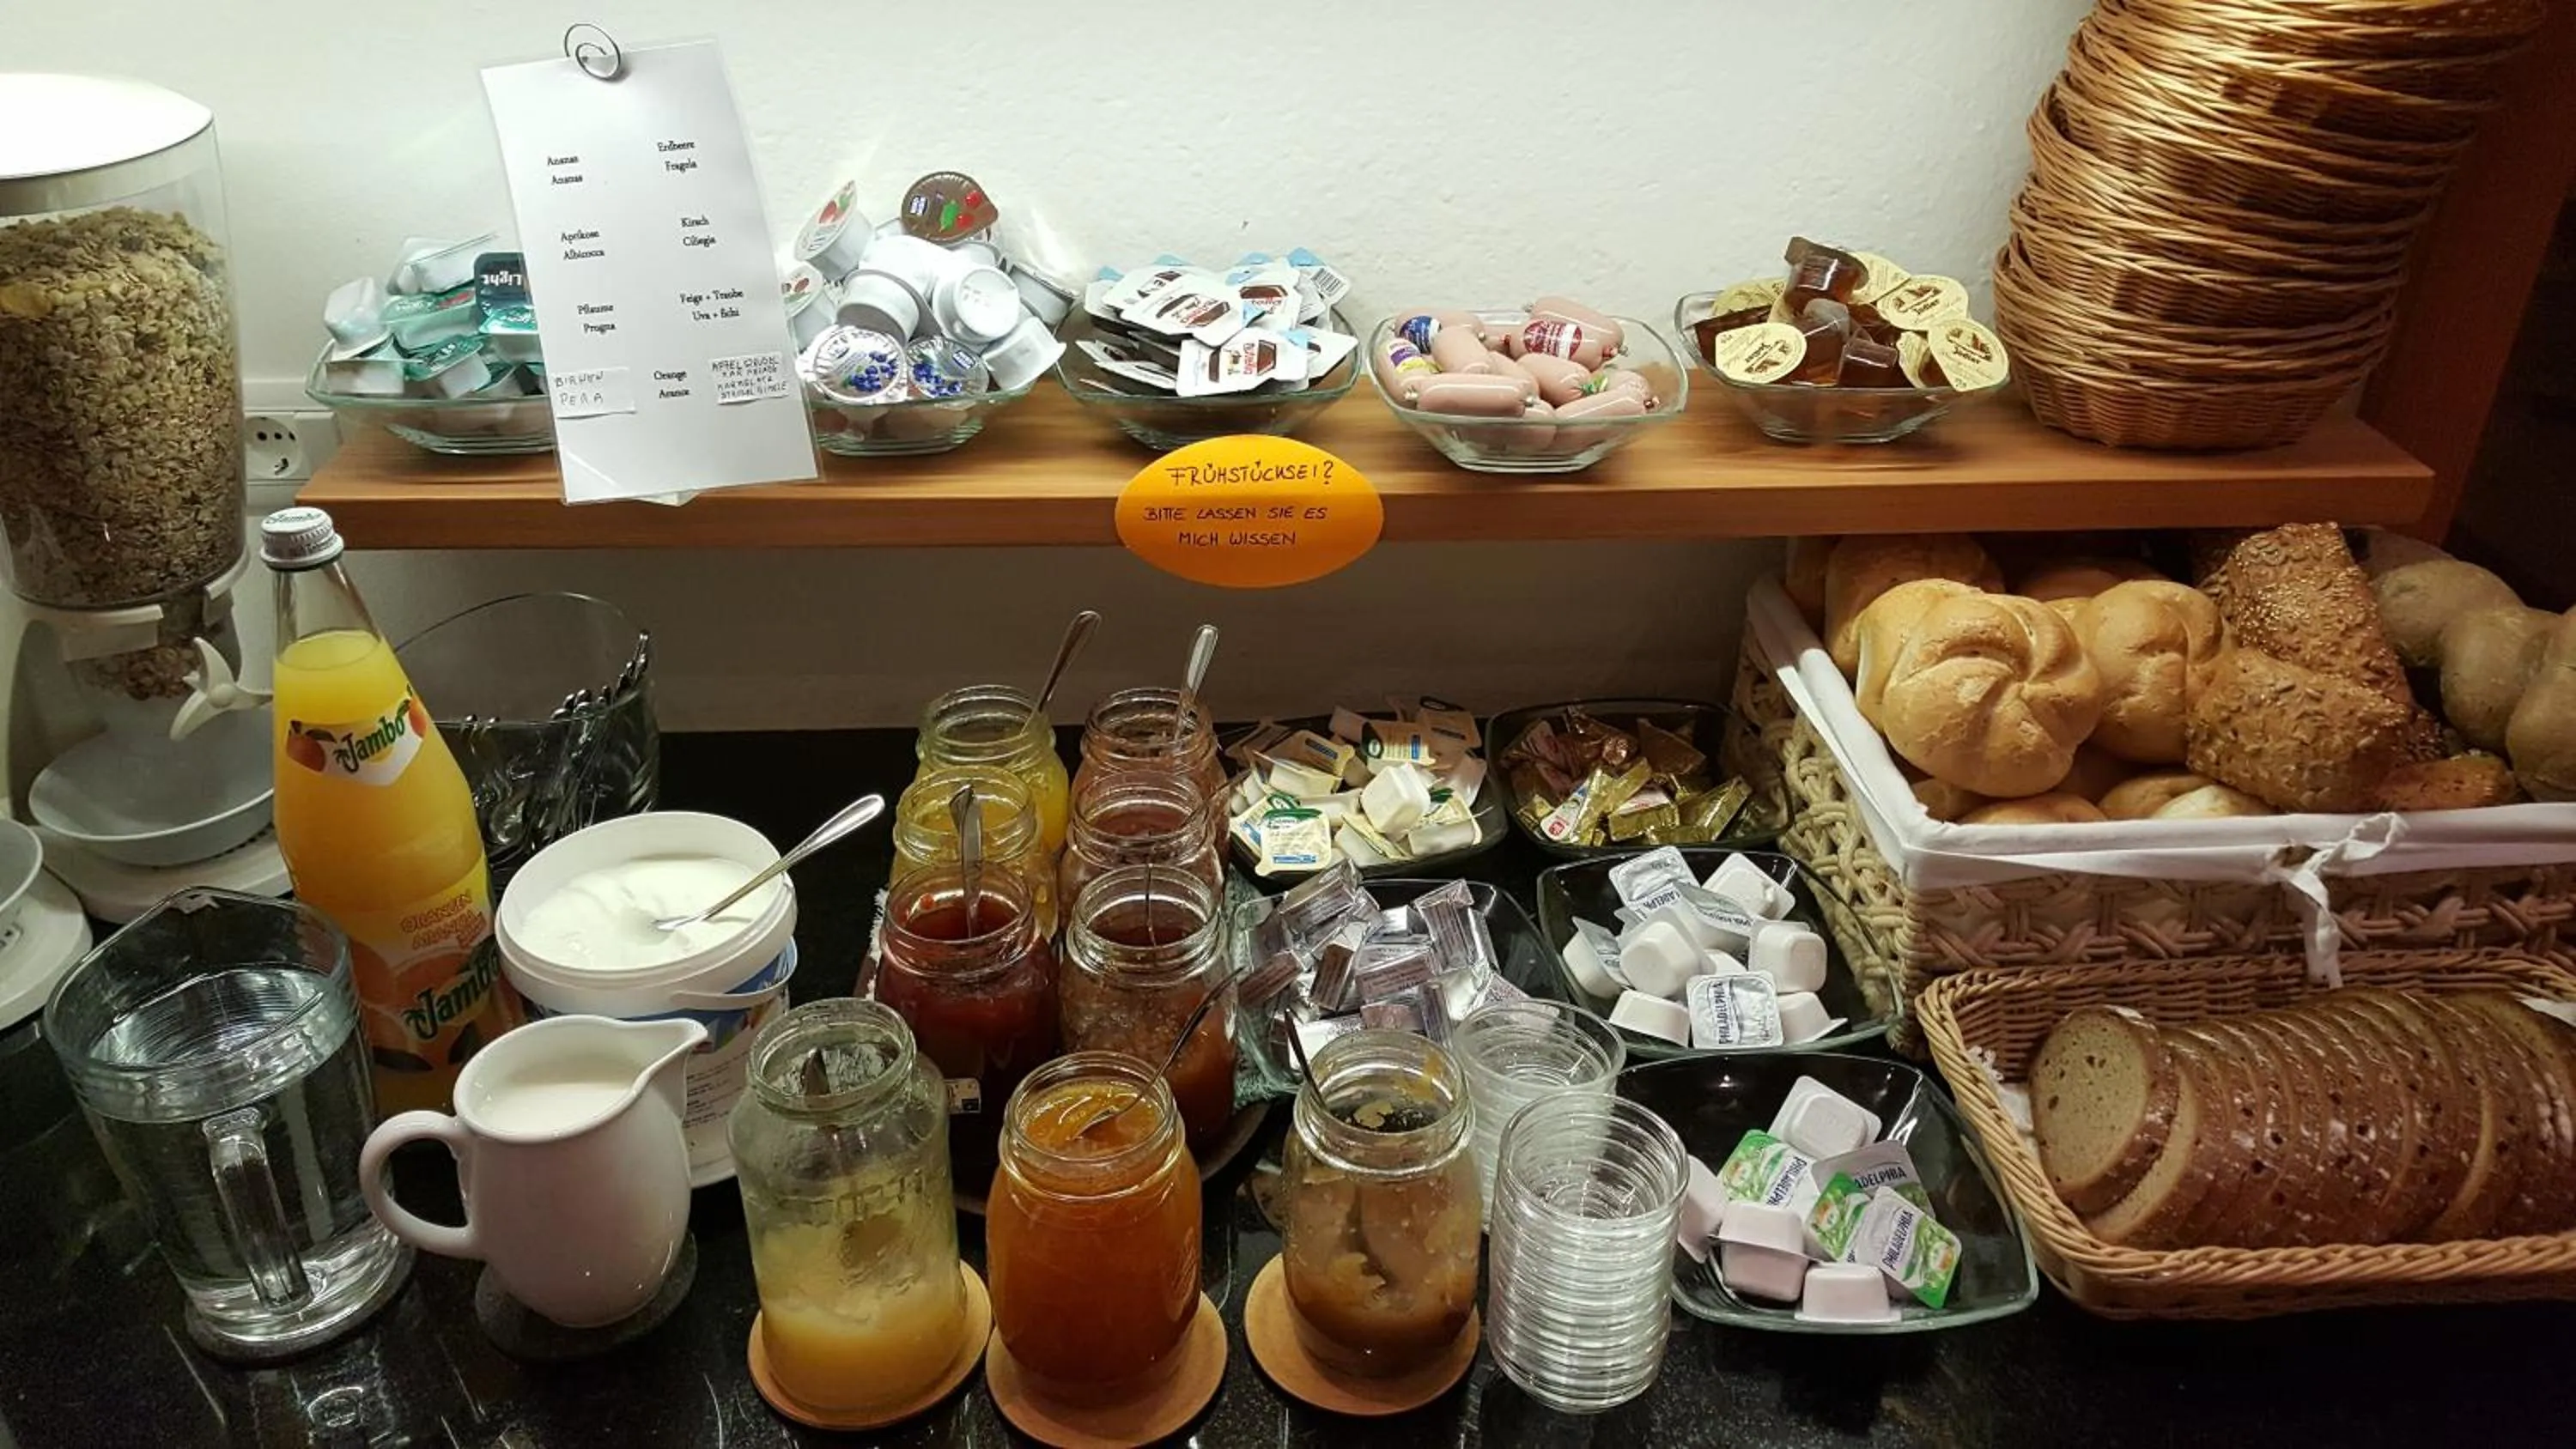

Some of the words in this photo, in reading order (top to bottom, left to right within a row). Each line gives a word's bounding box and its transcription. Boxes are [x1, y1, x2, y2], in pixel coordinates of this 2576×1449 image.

[547, 155, 580, 167] Ananas
[551, 174, 583, 185] Ananas
[480, 270, 522, 288] Light
[1143, 506, 1188, 521] BITTE
[1196, 506, 1256, 520] LASSEN
[1267, 505, 1294, 519] SIE
[1303, 506, 1328, 519] ES
[1178, 531, 1218, 547] MICH
[1229, 531, 1297, 546] WISSEN
[332, 715, 404, 774] Jambo
[1854, 1166, 1908, 1189] ADELPHIA
[1880, 1209, 1915, 1272] PHILADELPHIA
